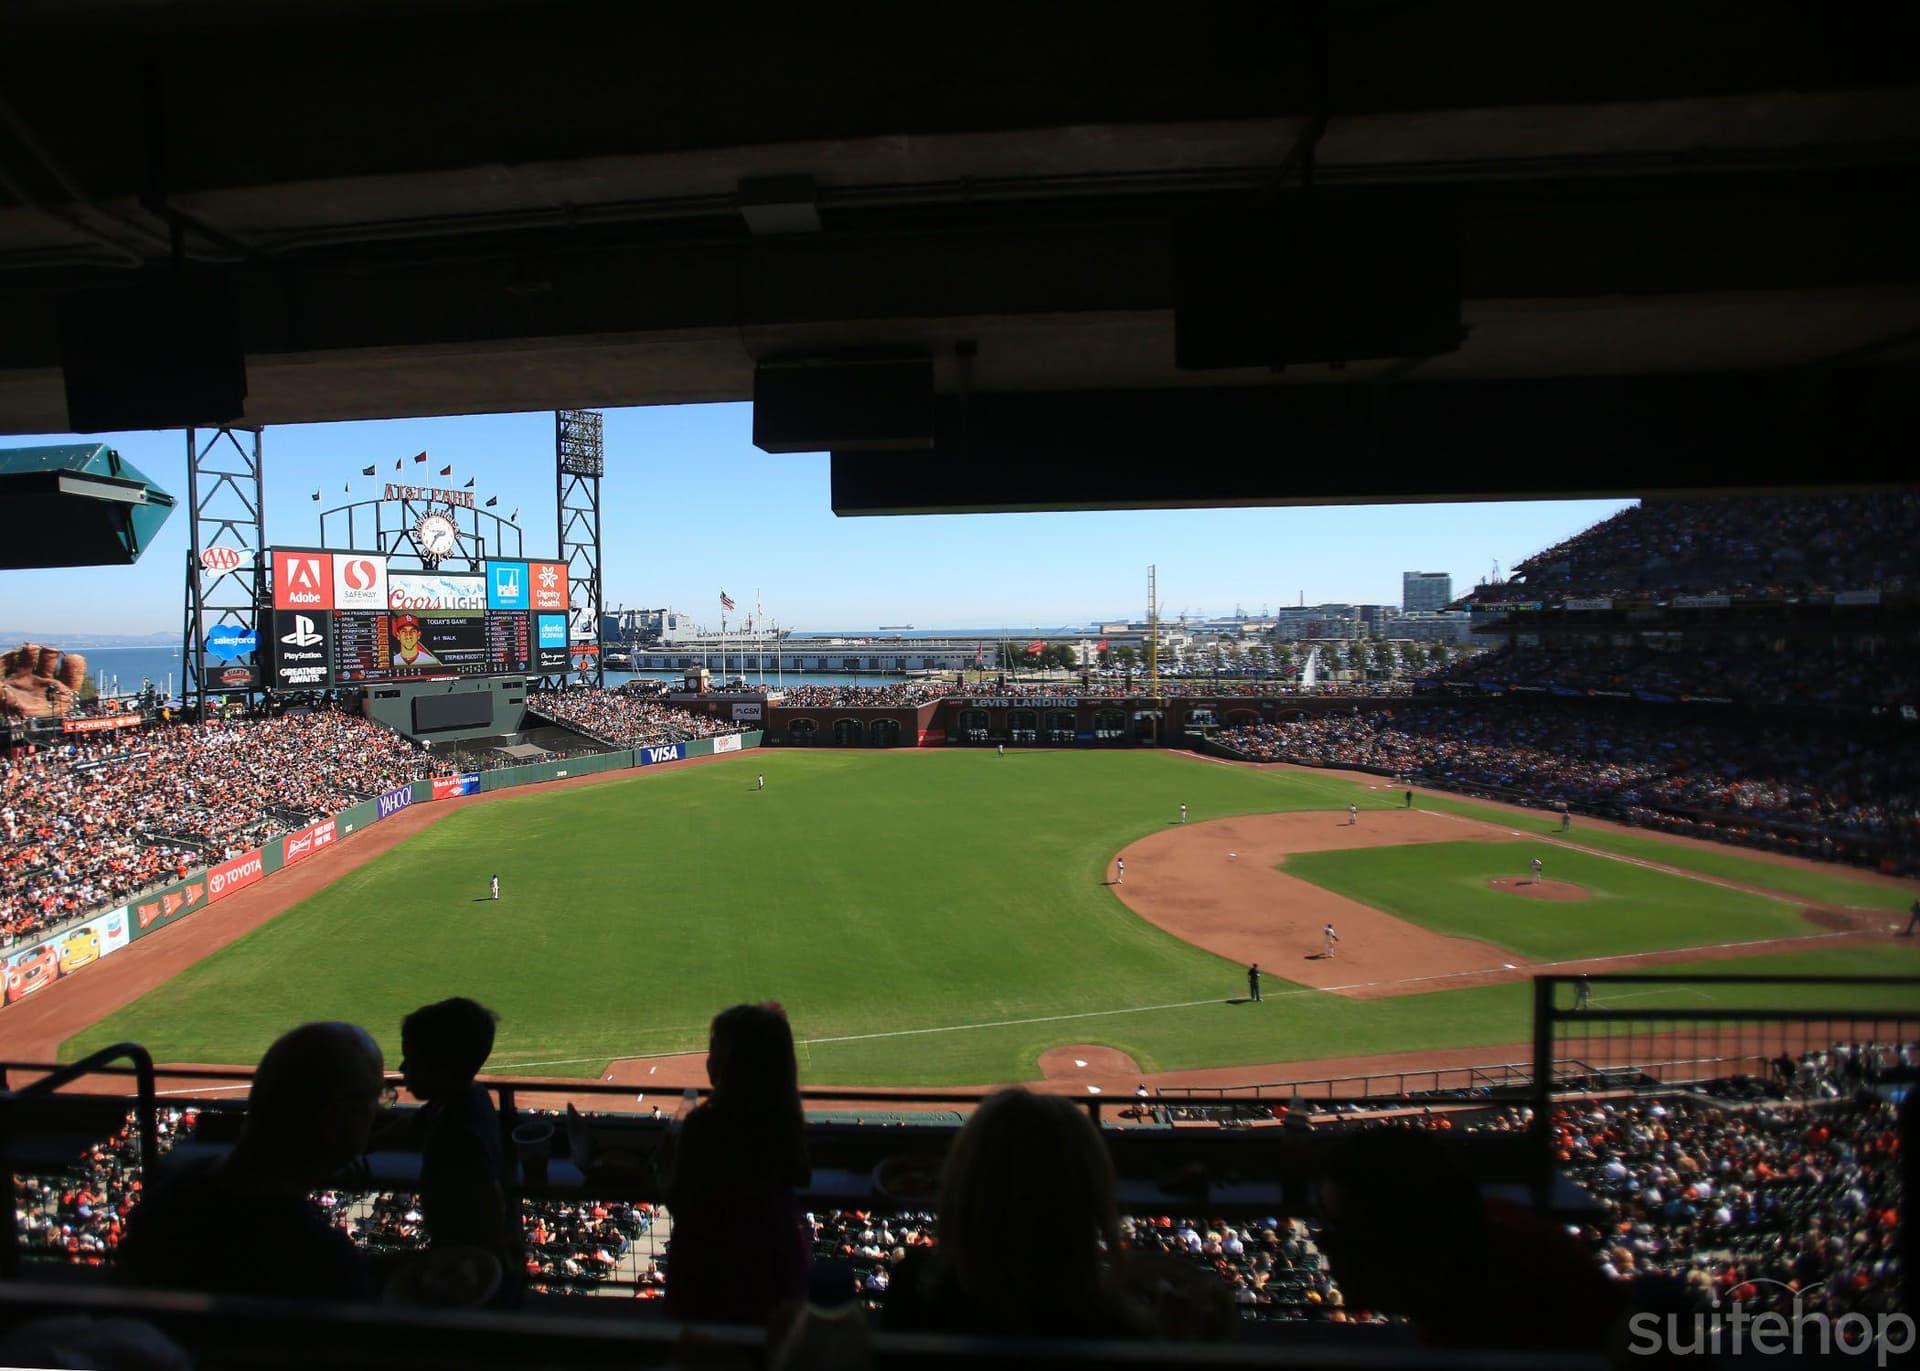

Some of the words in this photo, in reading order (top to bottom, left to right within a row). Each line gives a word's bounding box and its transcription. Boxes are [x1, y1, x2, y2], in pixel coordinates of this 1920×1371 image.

[384, 483, 425, 501] AT&T
[432, 488, 475, 509] PARK
[205, 549, 238, 568] AAA
[289, 592, 320, 603] Adobe
[344, 590, 377, 599] SAFEWAY
[388, 588, 442, 610] Coors
[444, 597, 486, 610] LIGHT
[536, 589, 560, 600] Dignity
[538, 599, 561, 607] Health
[213, 635, 257, 646] salesforce
[284, 652, 321, 661] PlayStation
[280, 667, 327, 677] GREATNESS
[1013, 698, 1079, 708] LANDING
[743, 707, 760, 715] CSN
[647, 745, 679, 763] VISA
[433, 779, 449, 789] Bank
[455, 775, 479, 785] America
[379, 785, 412, 817] YAHOO!
[225, 858, 262, 885] TOYOTA
